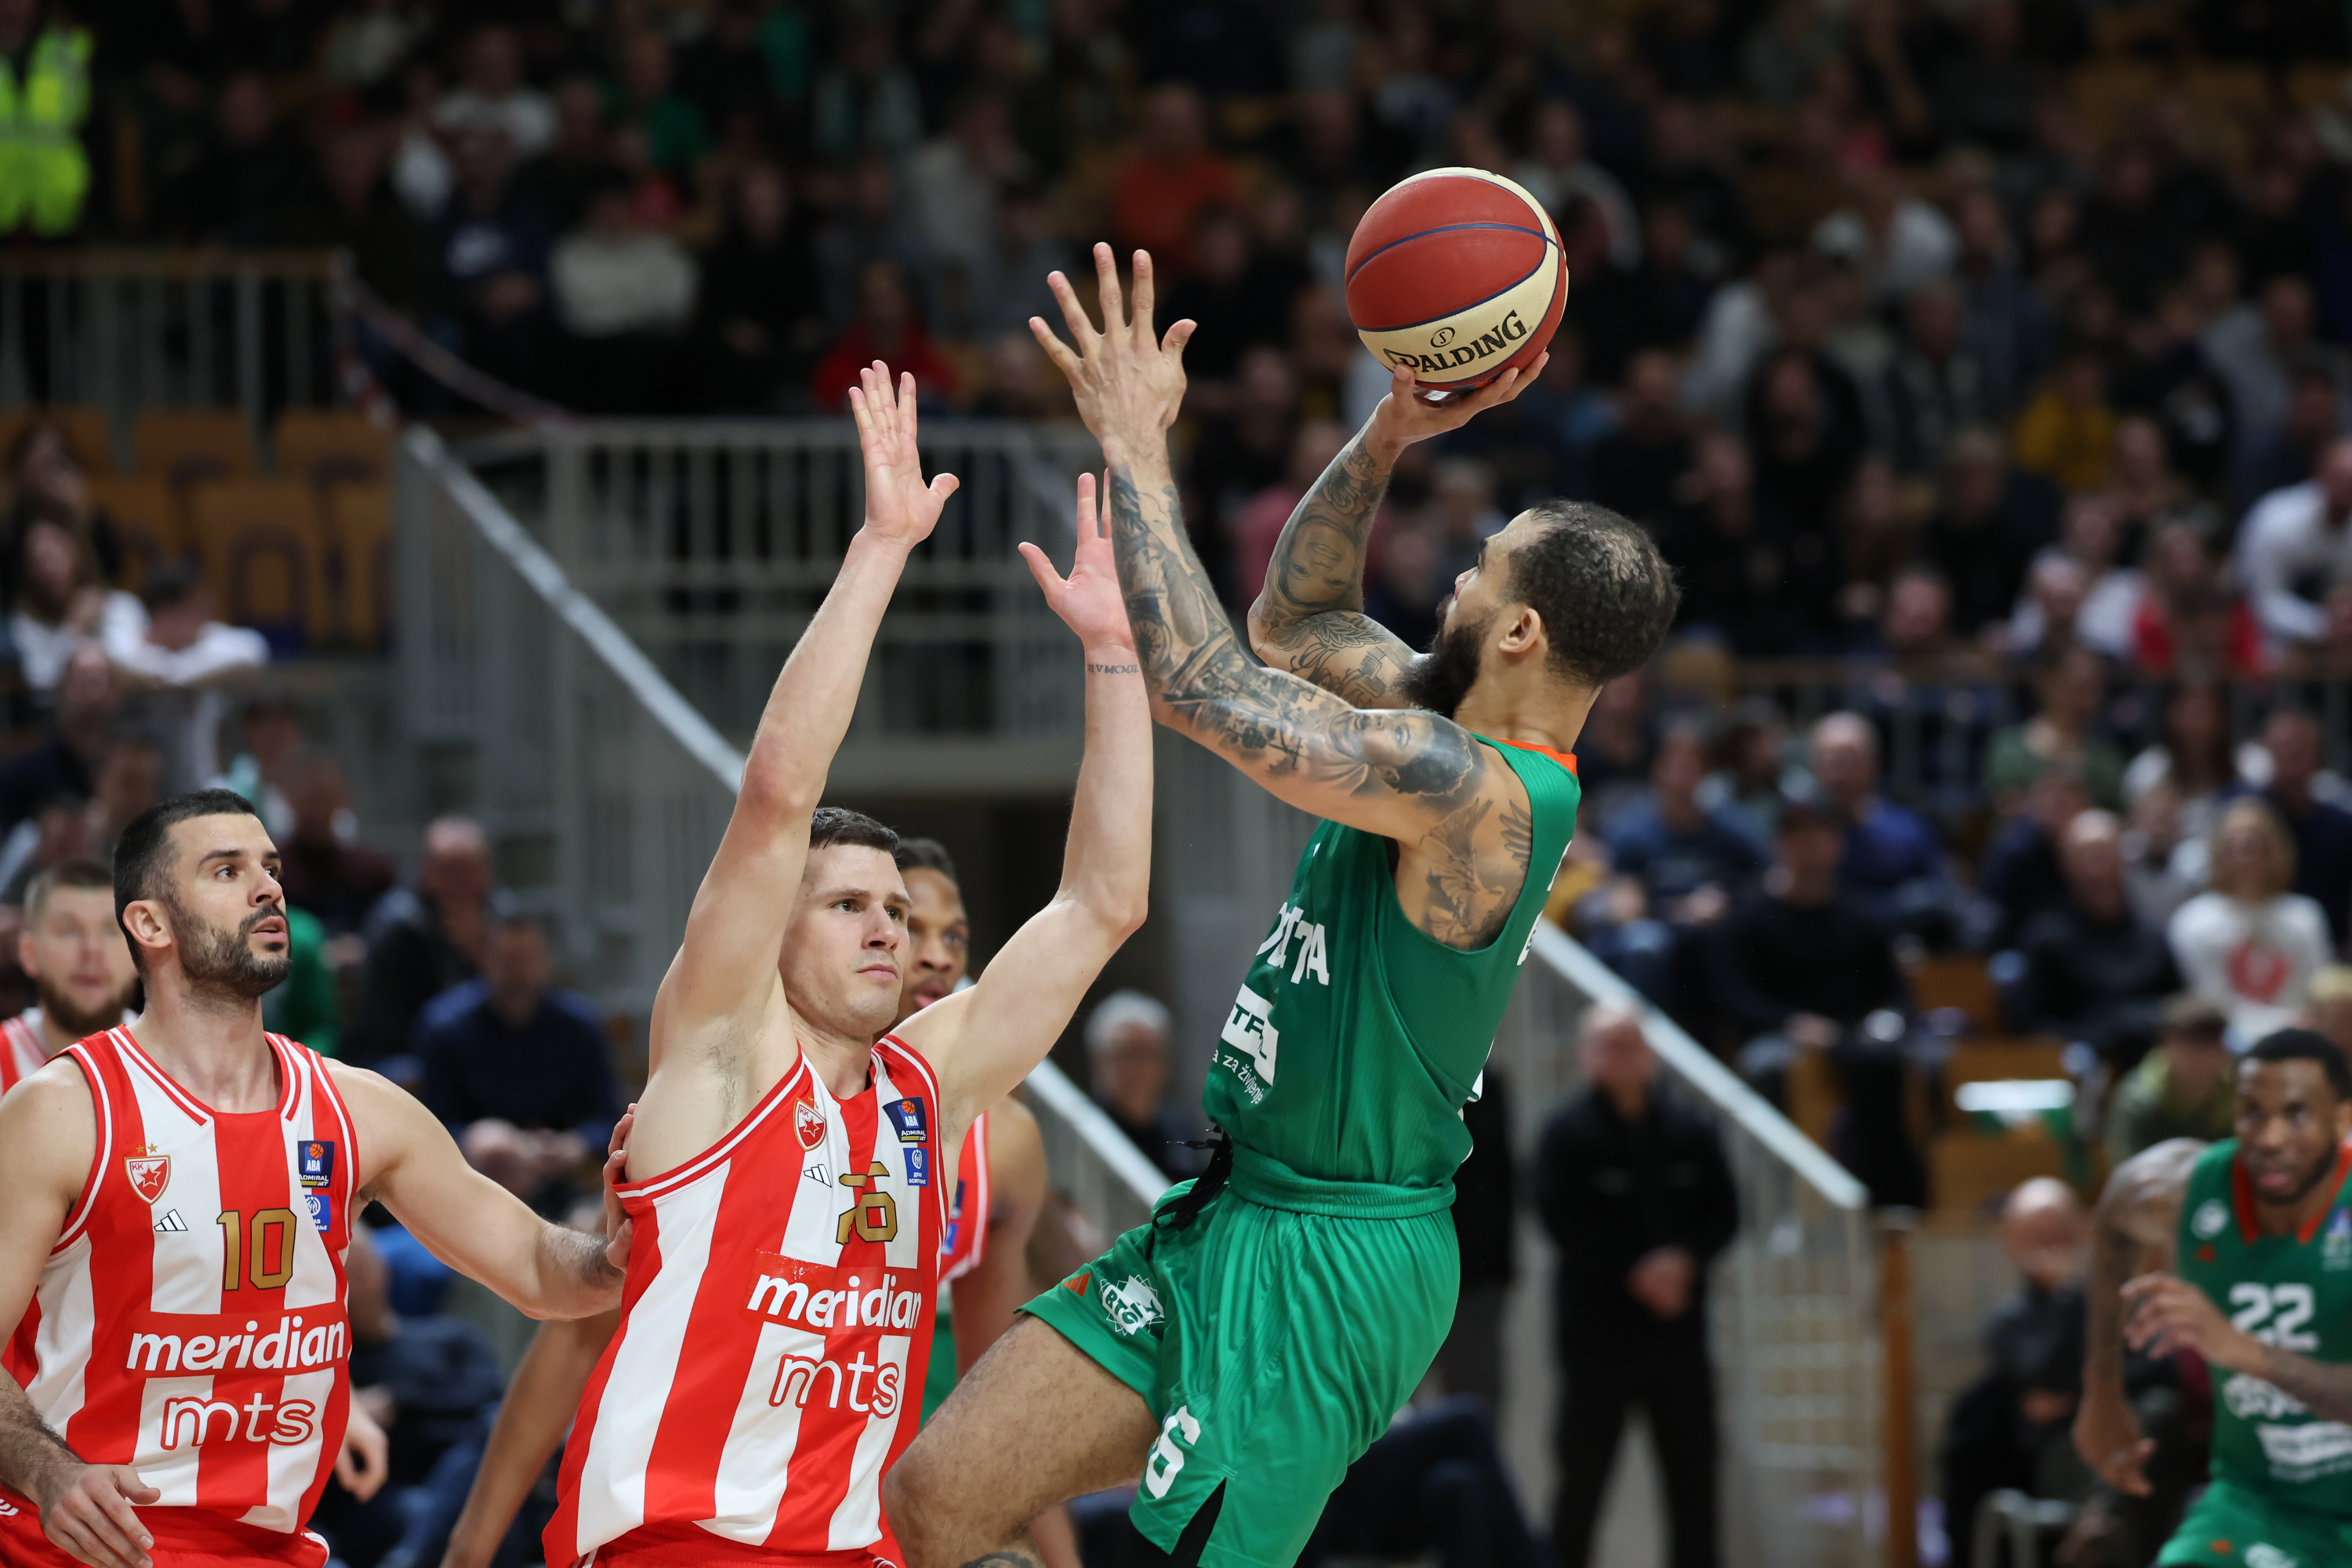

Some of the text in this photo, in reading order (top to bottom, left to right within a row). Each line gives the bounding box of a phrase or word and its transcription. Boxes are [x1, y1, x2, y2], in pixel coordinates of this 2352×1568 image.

[800, 1106, 809, 1118] KK
[904, 1115, 919, 1127] ABA
[299, 1174, 329, 1182] ADMIRAL
[306, 1160, 321, 1172] ABA
[216, 1207, 297, 1291] 10
[746, 1273, 923, 1330] meridian
[2229, 1282, 2319, 1350] 22
[126, 1316, 345, 1372] meridian
[771, 1351, 899, 1416] mts
[163, 1392, 315, 1448] mts
